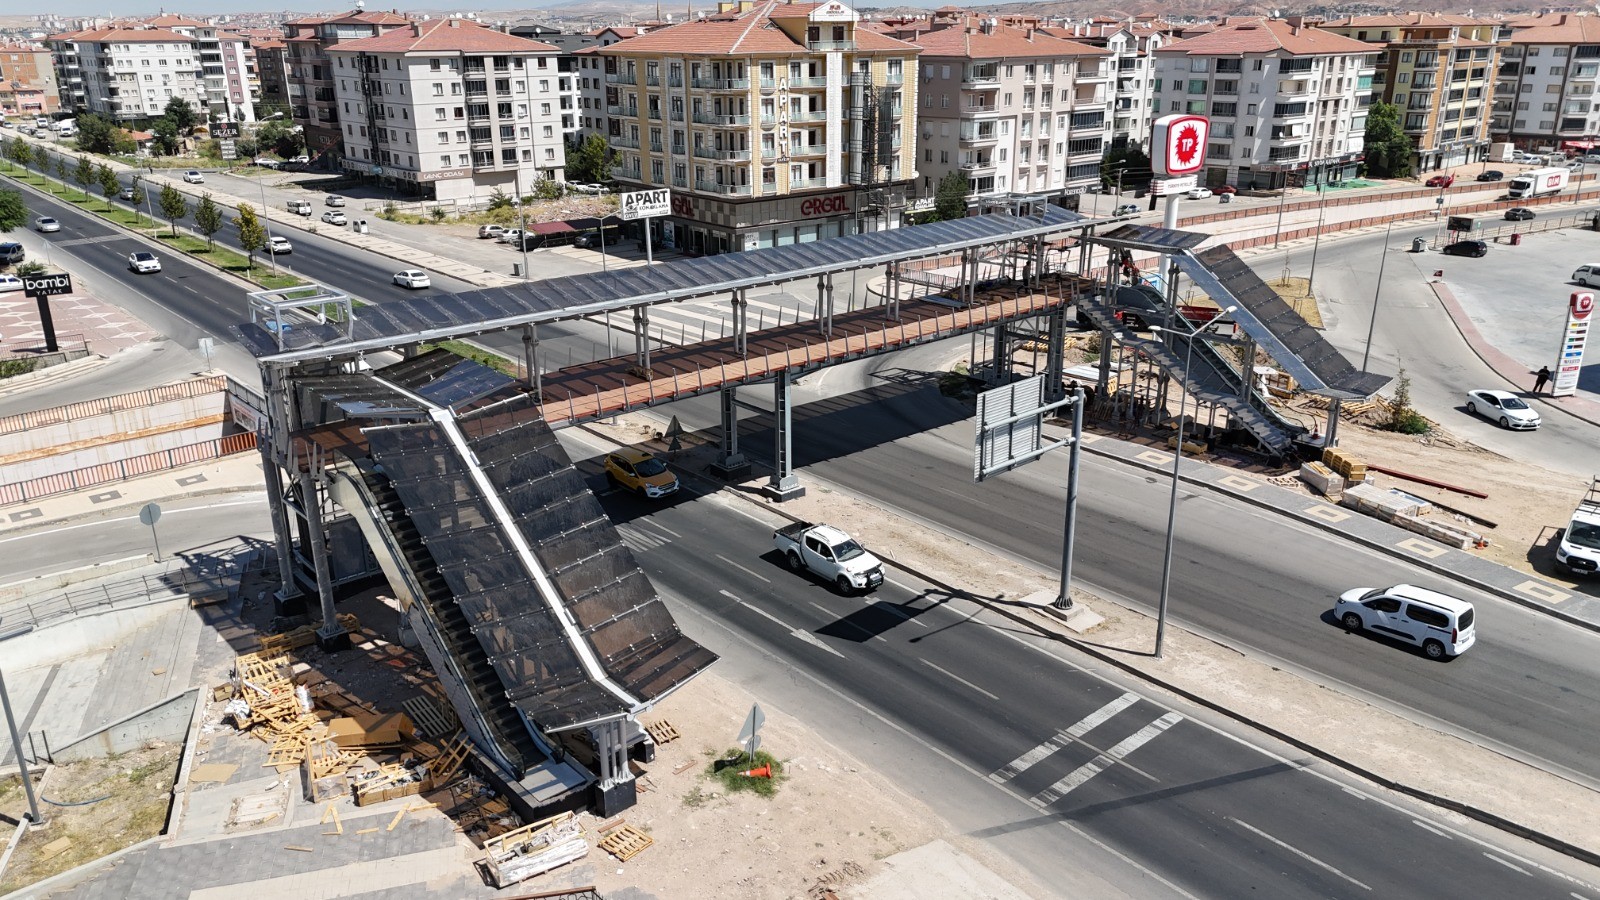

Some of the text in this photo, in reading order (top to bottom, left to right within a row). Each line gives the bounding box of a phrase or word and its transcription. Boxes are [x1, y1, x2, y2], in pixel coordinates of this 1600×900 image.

[1181, 138, 1194, 152] TP
[624, 190, 668, 207] APART
[25, 275, 70, 290] bambi
